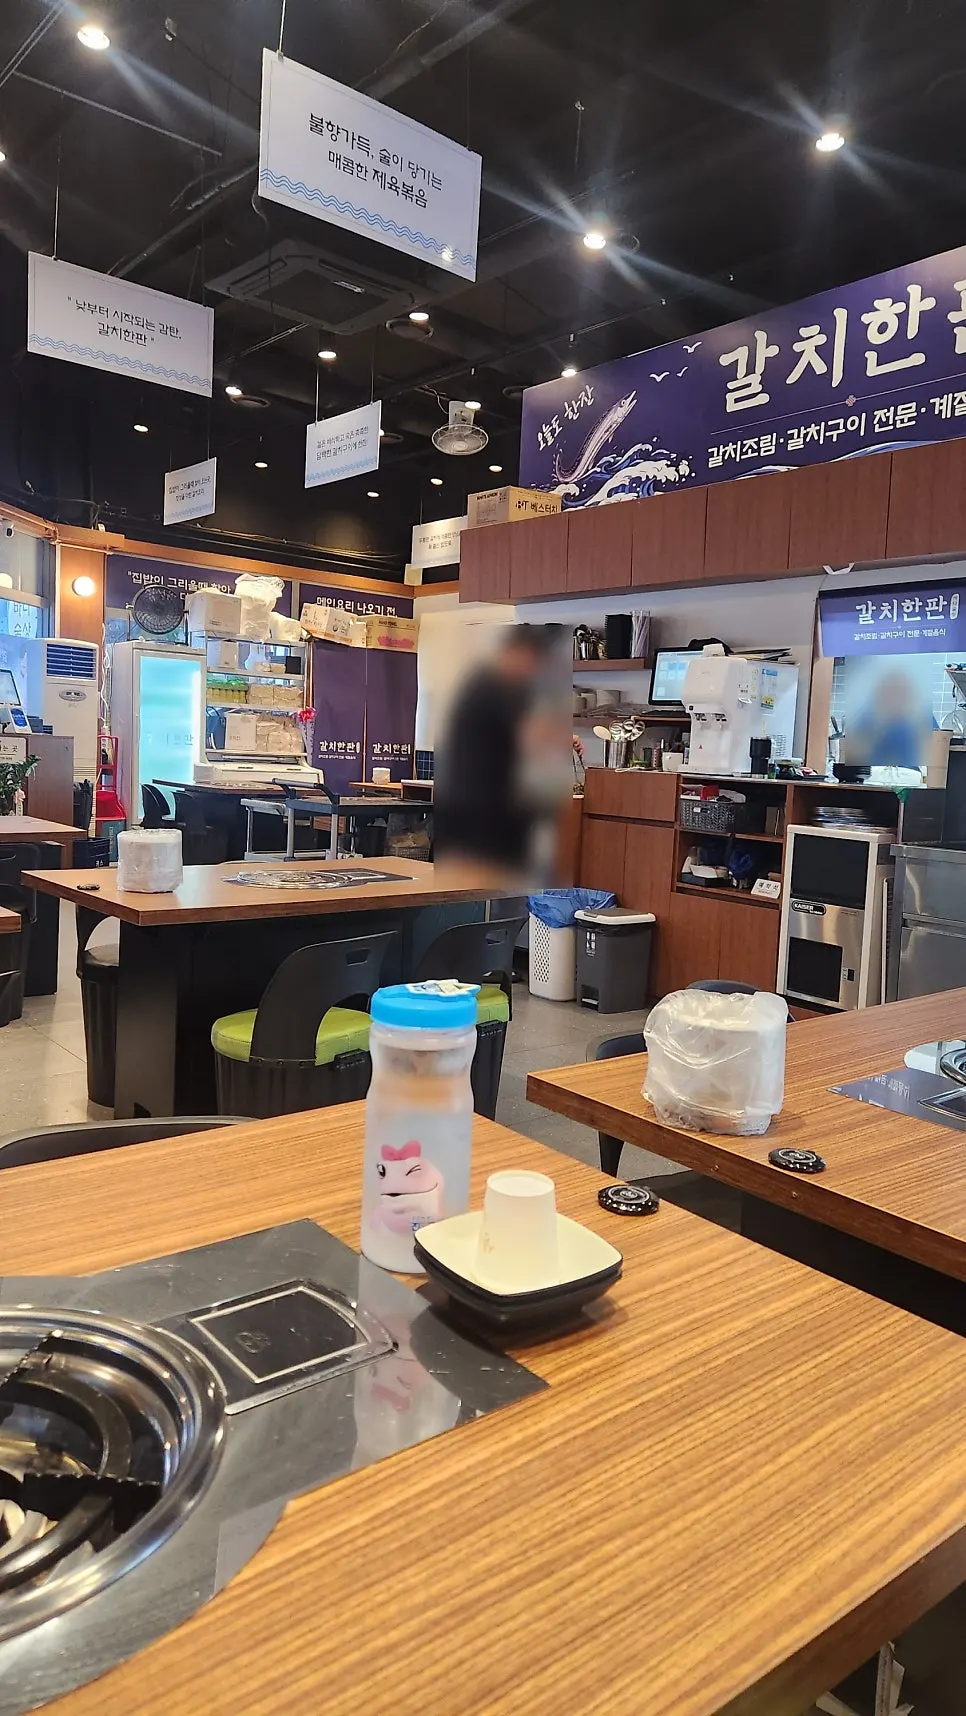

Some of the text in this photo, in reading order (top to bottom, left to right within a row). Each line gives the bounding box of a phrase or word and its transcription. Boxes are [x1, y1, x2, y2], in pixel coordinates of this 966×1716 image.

[308, 112, 443, 191] 불향가득, 술이 당기는
[328, 150, 428, 208] 매콤한 제육볶음
[112, 310, 156, 332] 시작되는
[97, 322, 148, 347] 갈치한판
[537, 384, 594, 451] 오늘도 한잔
[530, 502, 558, 513] 베스터치
[357, 602, 384, 616] 나오기
[855, 595, 948, 625] 갈치한판
[319, 740, 356, 753] 갈치한판
[794, 903, 814, 911] KAISER
